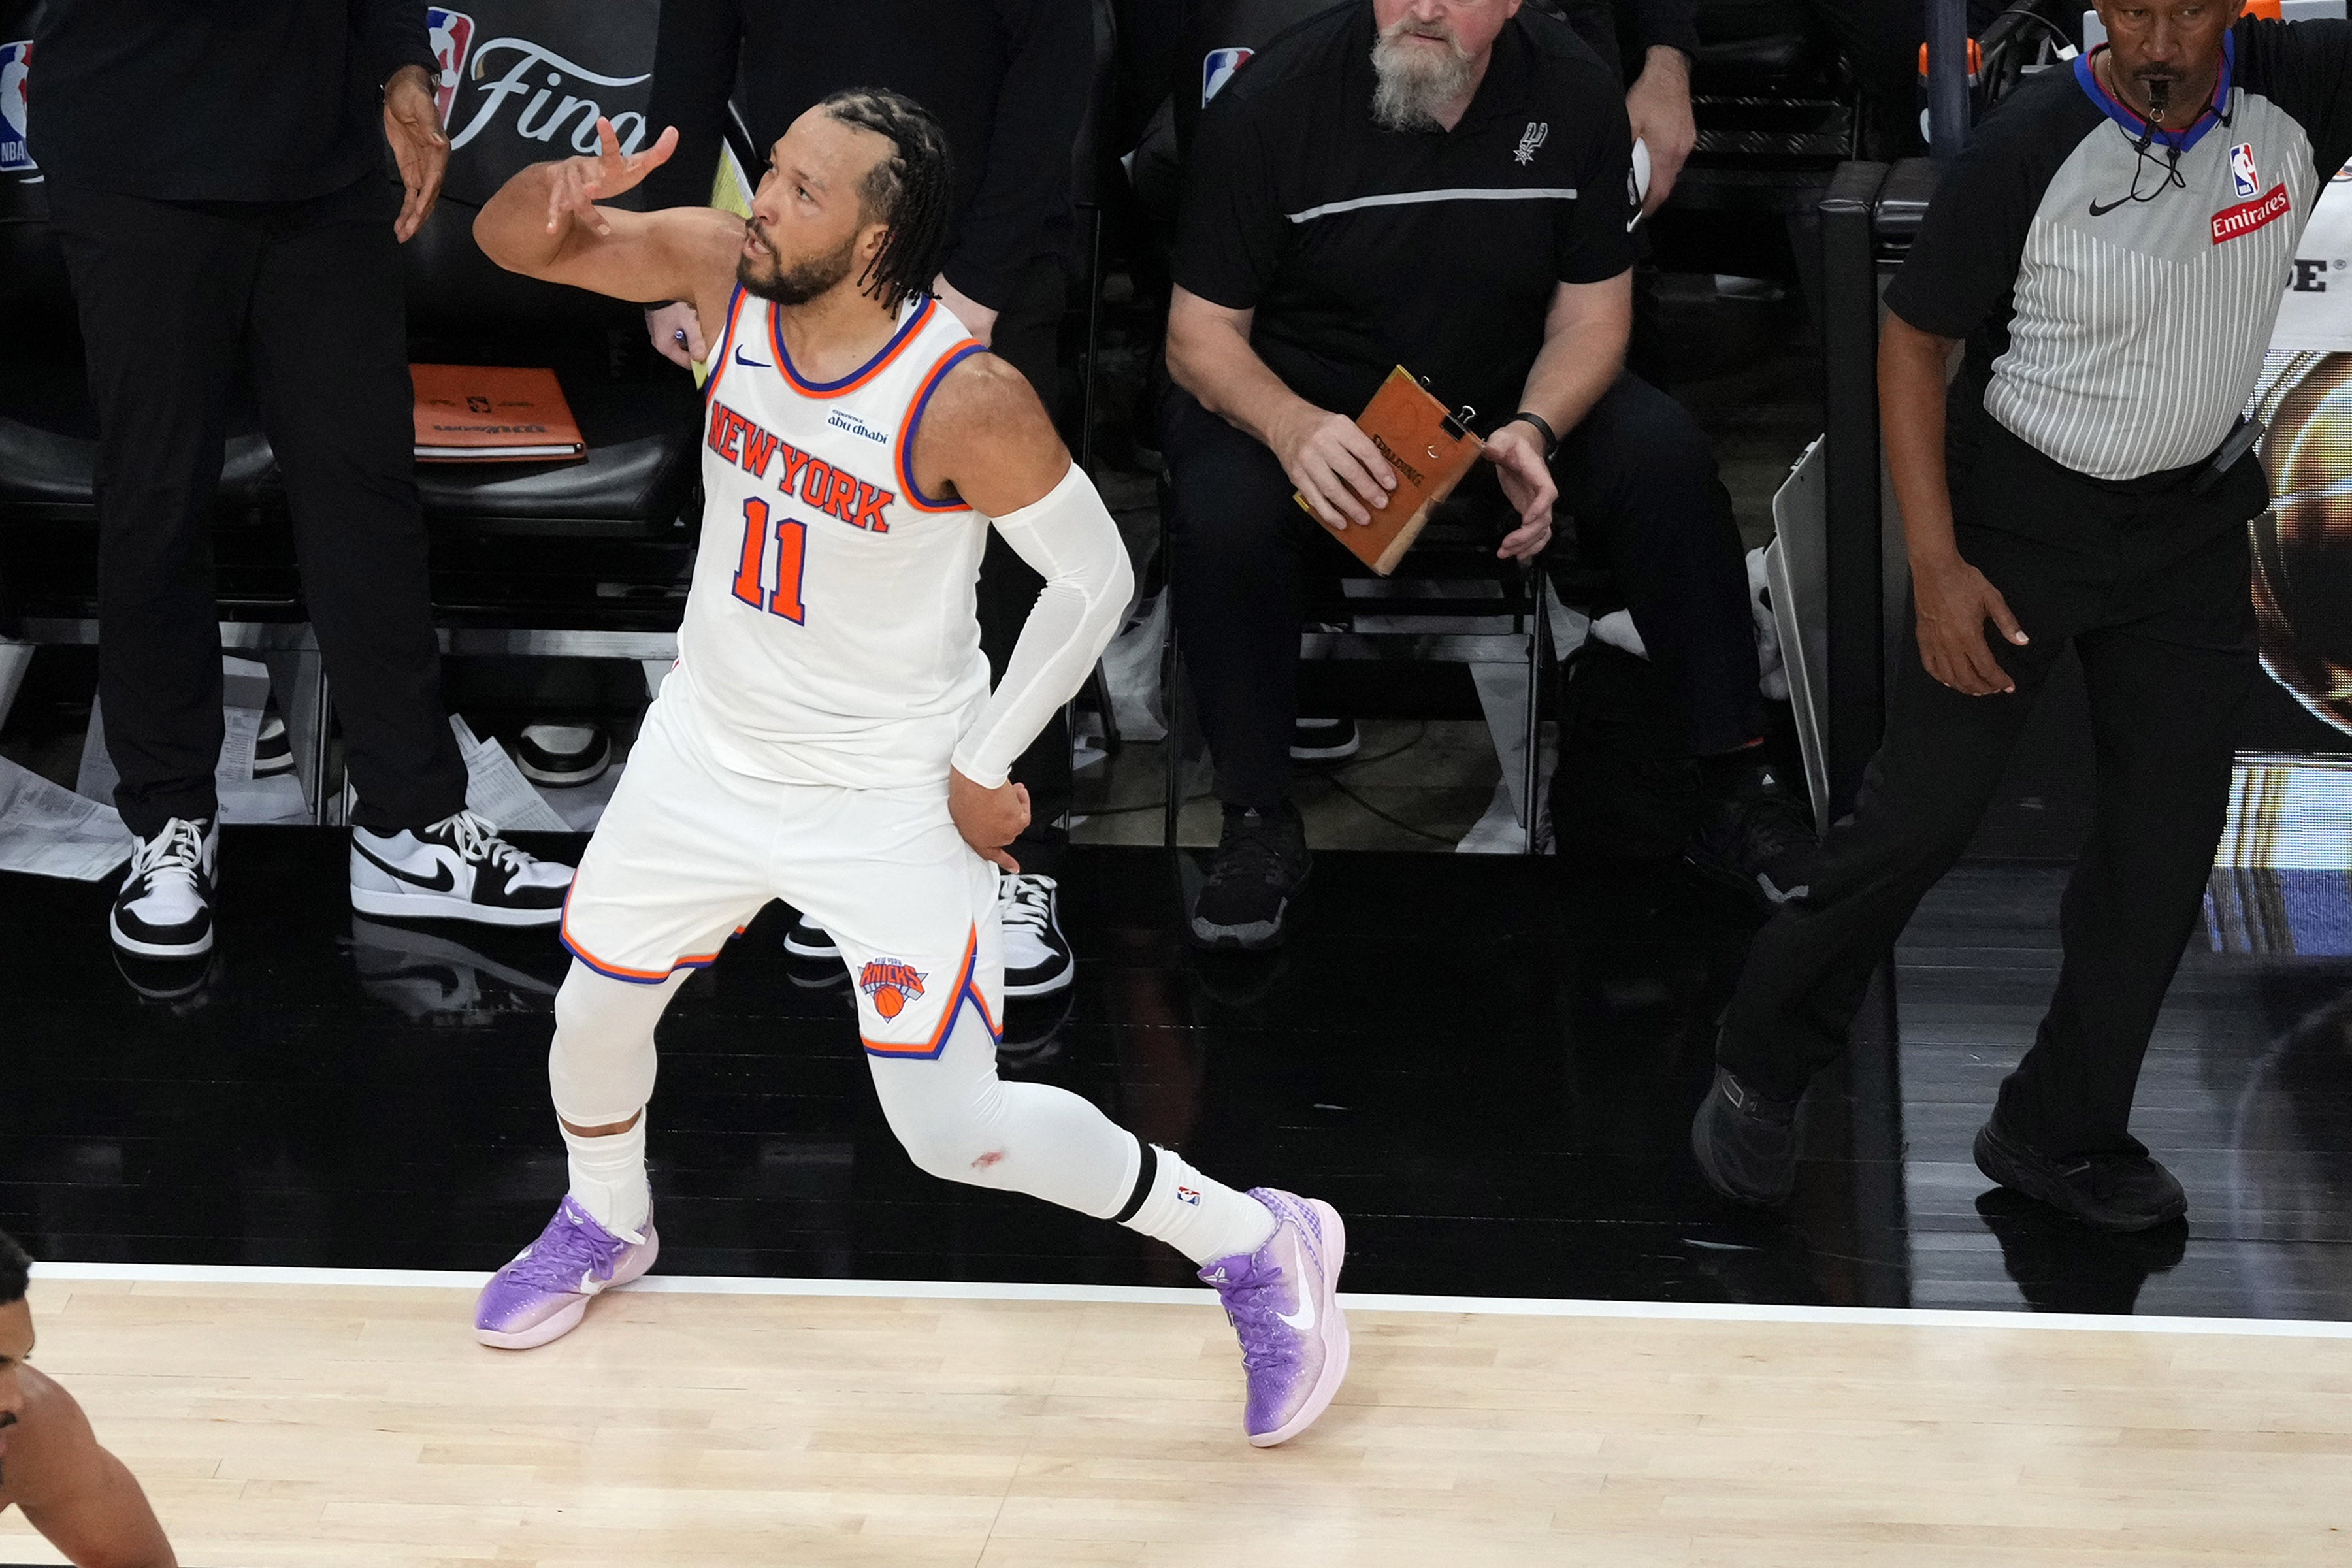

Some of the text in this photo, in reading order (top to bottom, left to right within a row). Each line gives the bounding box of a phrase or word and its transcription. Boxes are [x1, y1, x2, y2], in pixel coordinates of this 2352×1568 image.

[1, 140, 25, 162] NBA
[2213, 193, 2286, 237] Emirates
[828, 417, 888, 444] abu dhabi
[832, 410, 863, 423] experience
[708, 400, 896, 533] NEW YORK
[731, 496, 808, 627] 11
[860, 962, 924, 993] KNICKS
